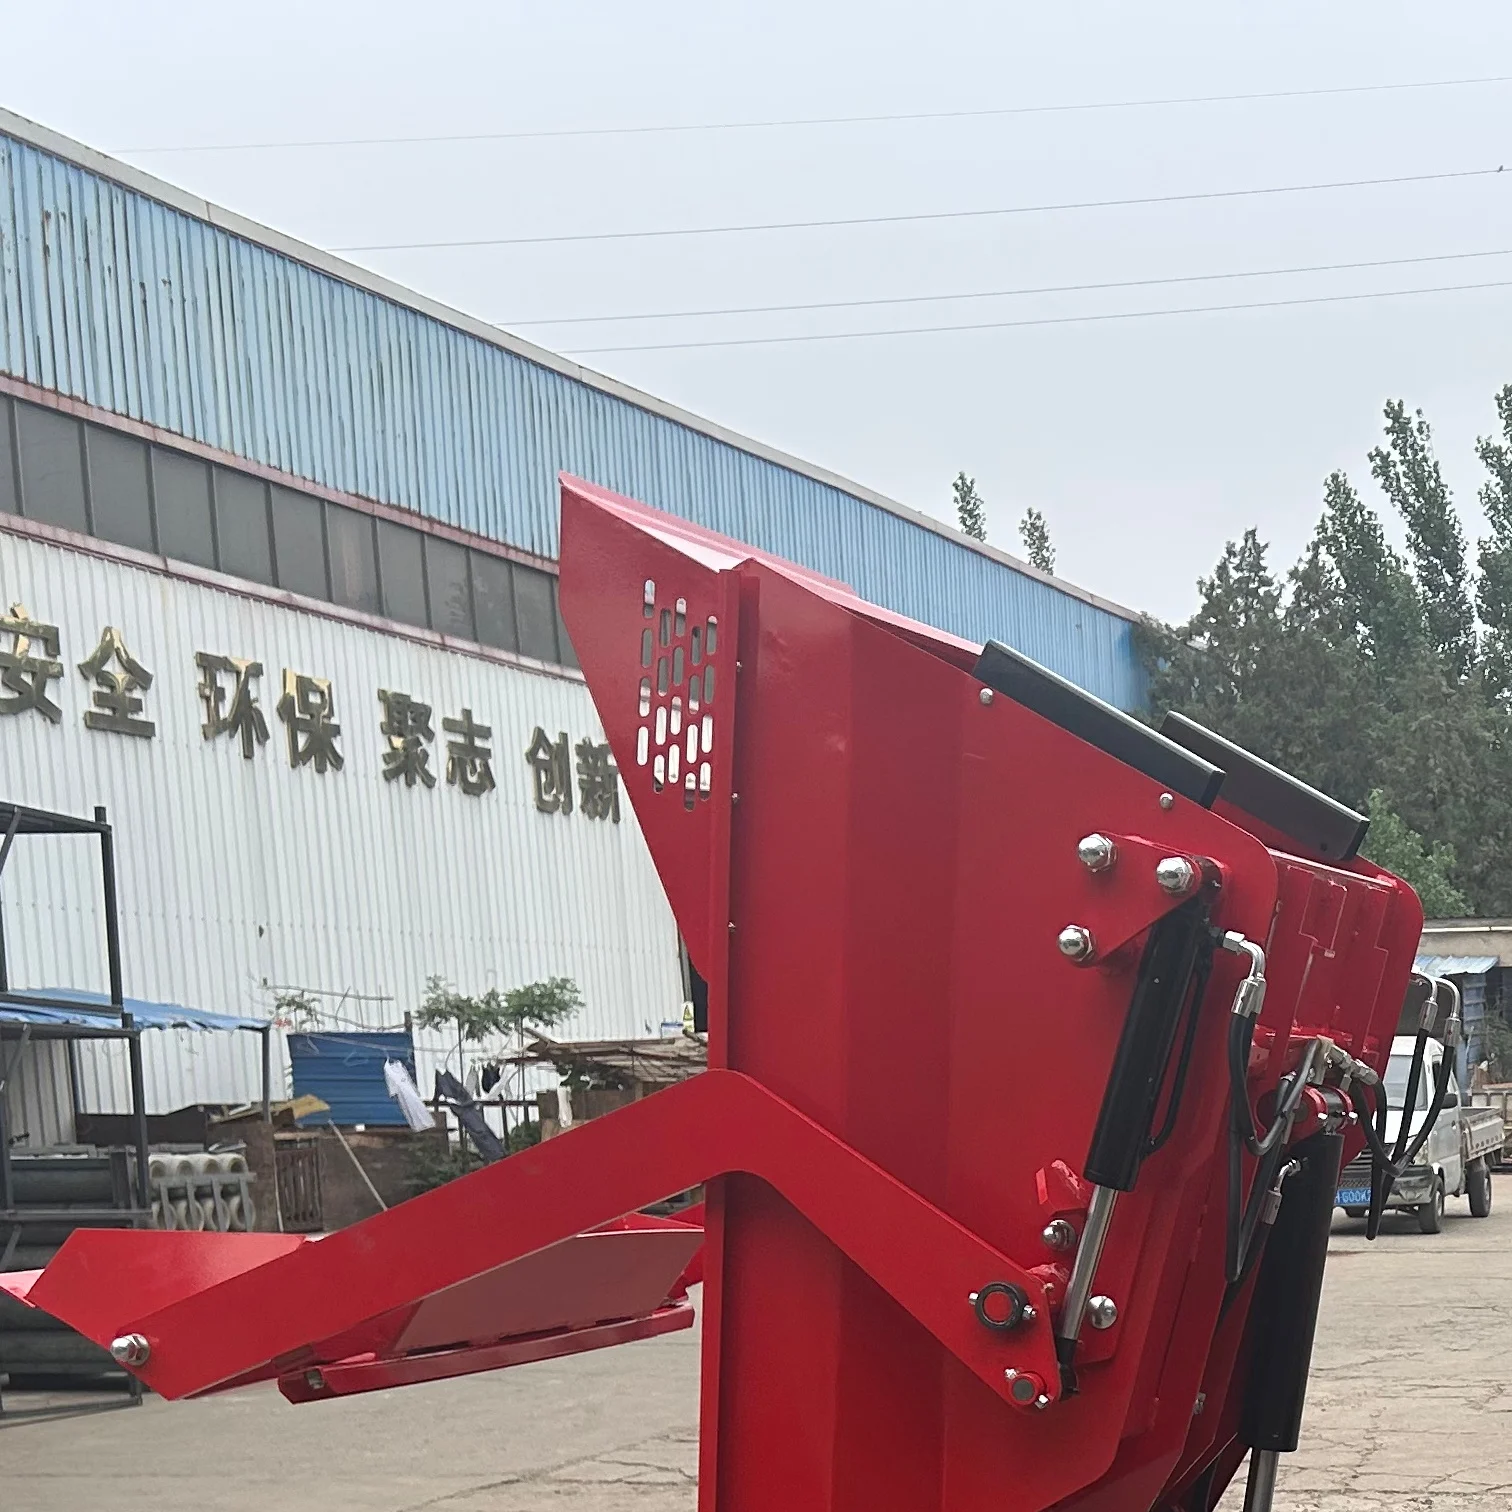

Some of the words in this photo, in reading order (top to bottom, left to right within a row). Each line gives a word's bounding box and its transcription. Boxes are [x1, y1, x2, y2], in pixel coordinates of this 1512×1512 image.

[0, 602, 156, 738] 安全
[195, 651, 343, 773] 环保
[378, 688, 496, 798] 聚志
[526, 726, 621, 825] 创新
